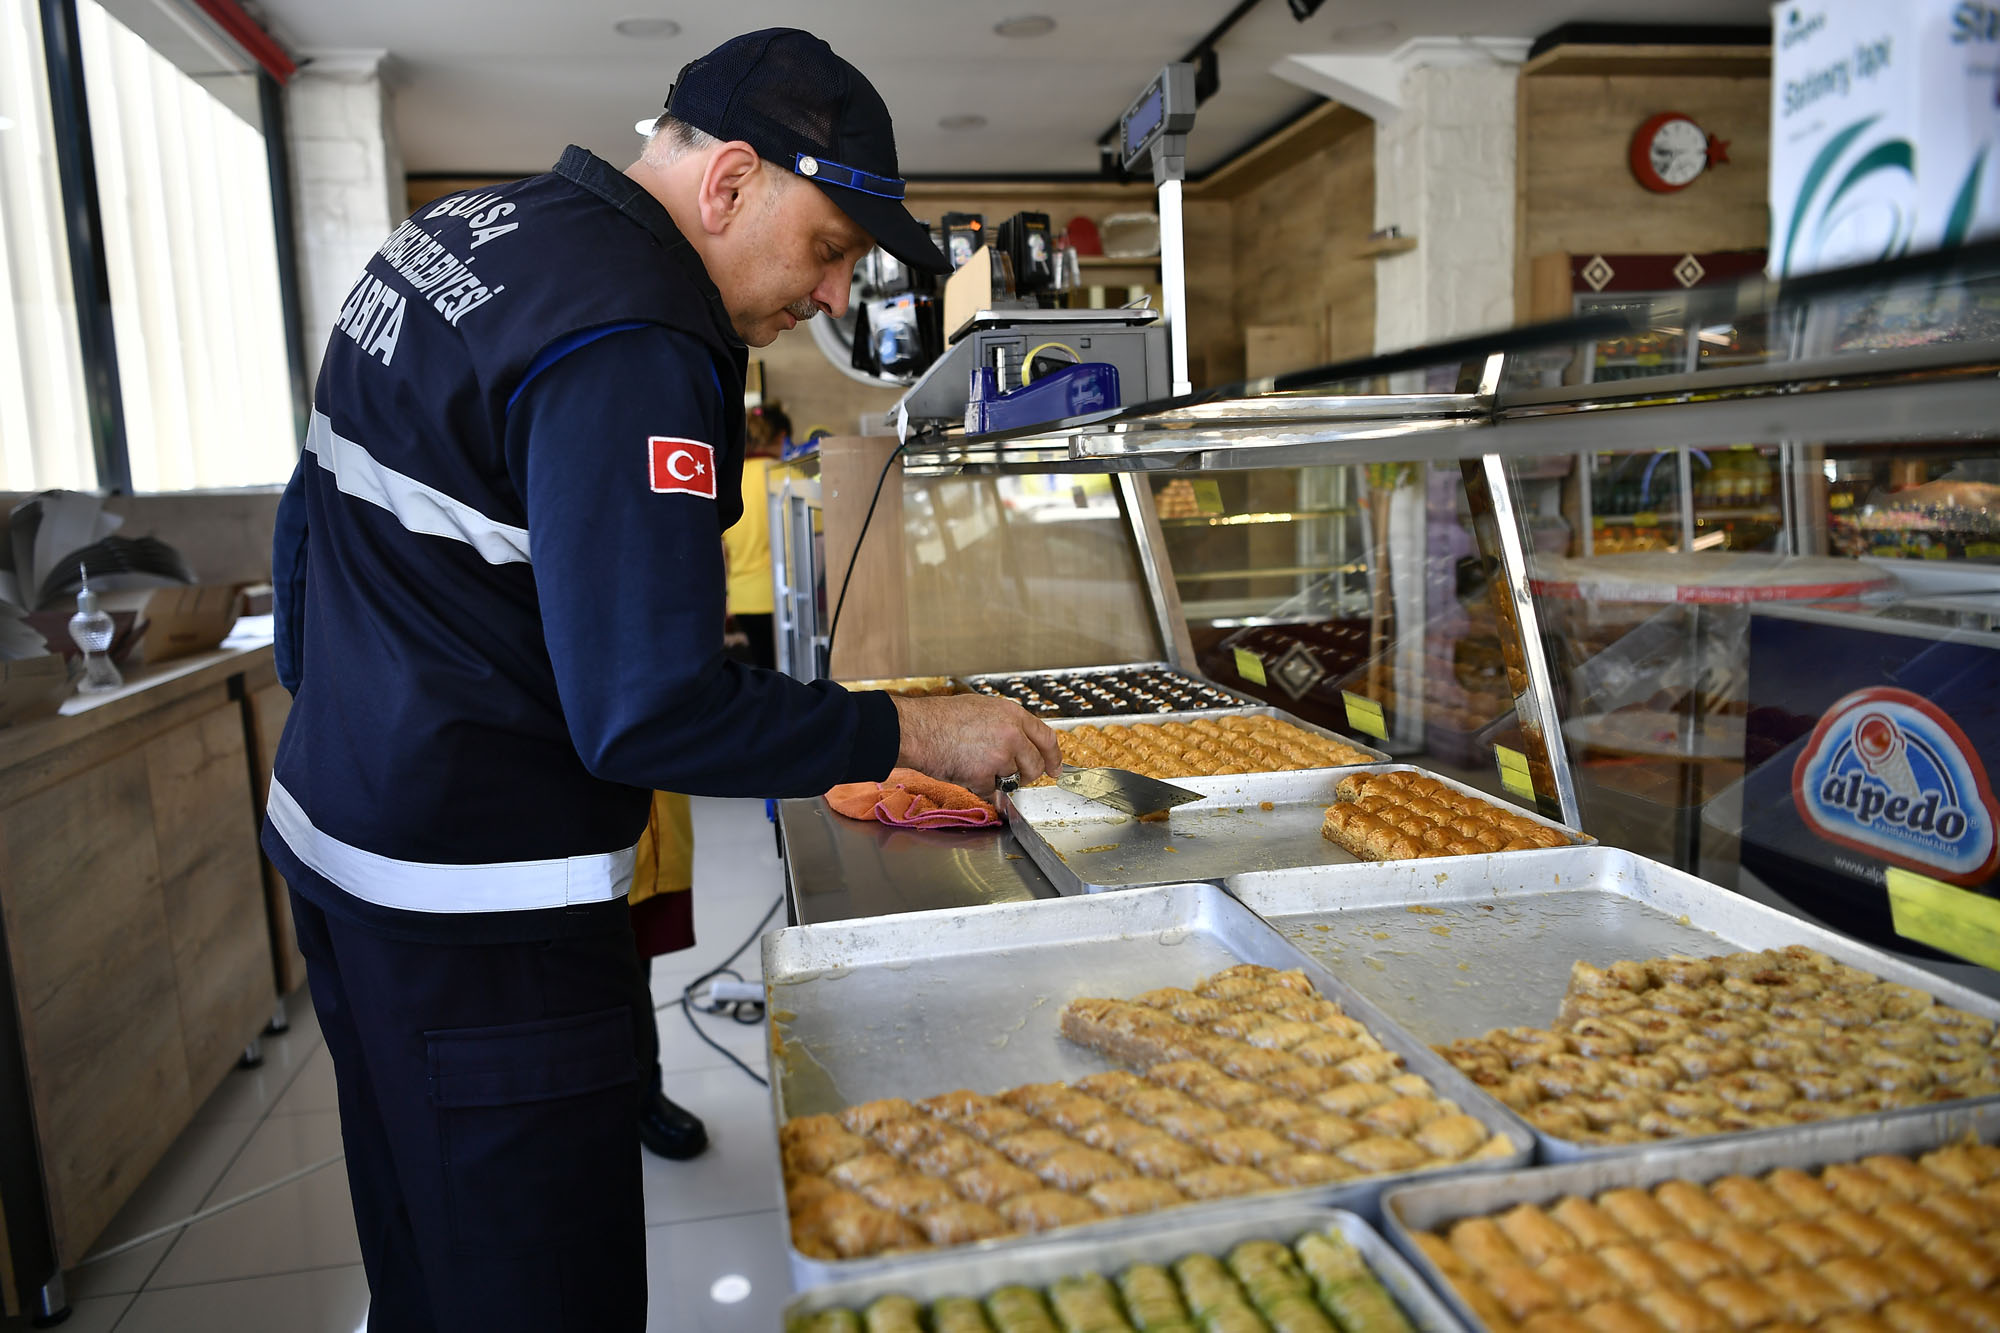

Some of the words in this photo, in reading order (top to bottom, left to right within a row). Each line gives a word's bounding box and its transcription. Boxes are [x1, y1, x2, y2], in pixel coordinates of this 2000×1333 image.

[336, 269, 407, 367] ABITA
[398, 237, 504, 328] BELEDİYESİ
[1821, 771, 1966, 841] alpedo
